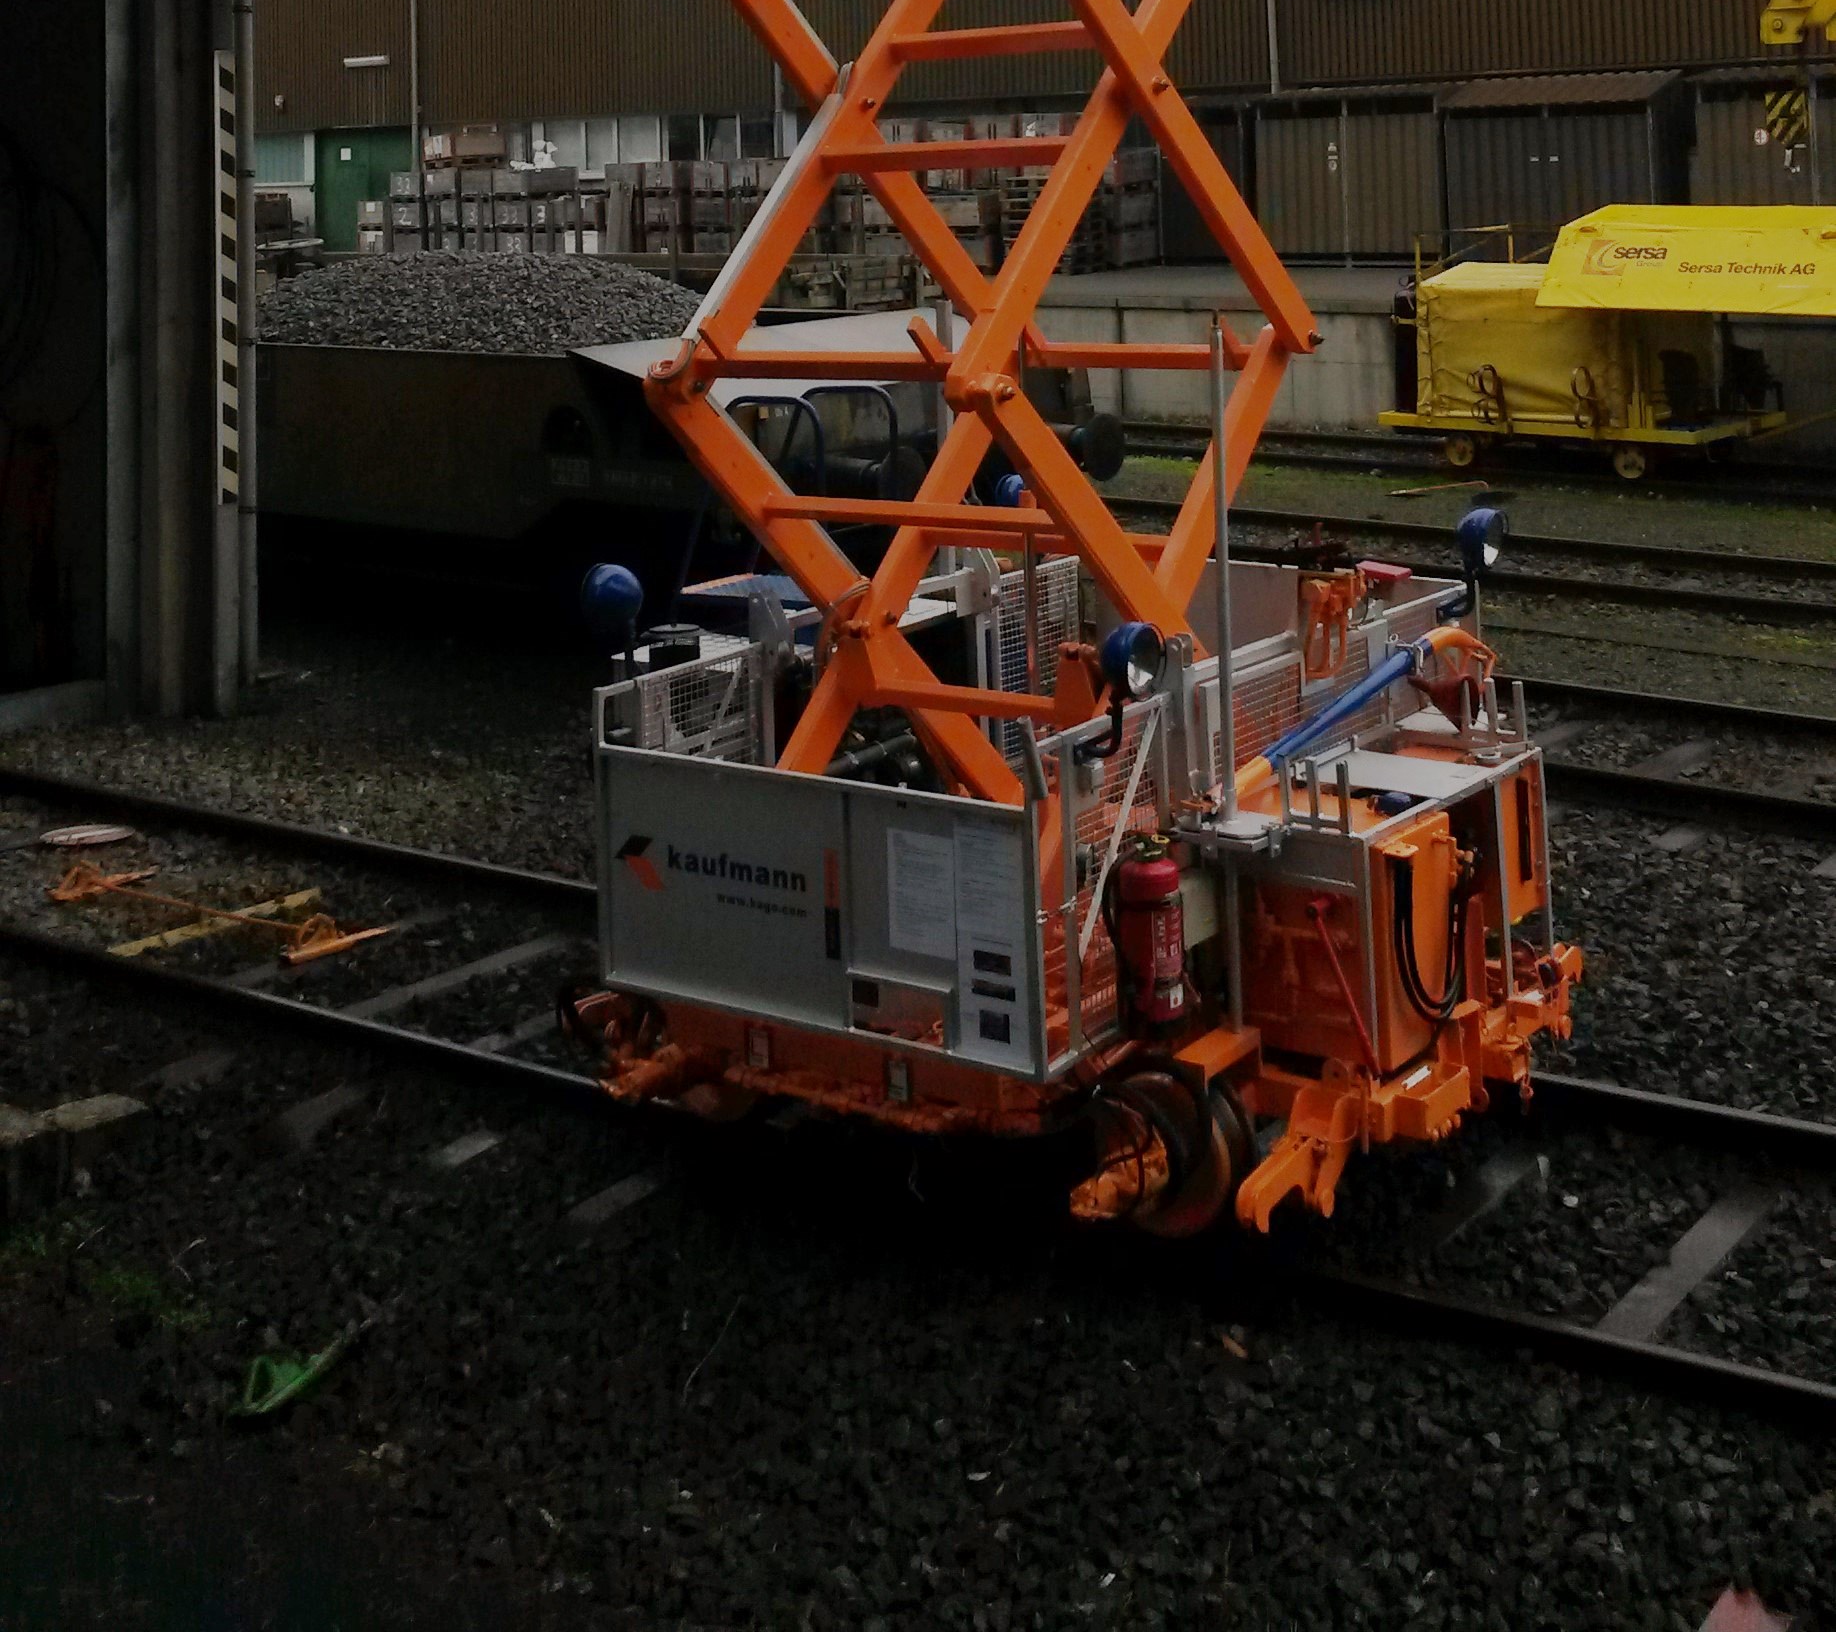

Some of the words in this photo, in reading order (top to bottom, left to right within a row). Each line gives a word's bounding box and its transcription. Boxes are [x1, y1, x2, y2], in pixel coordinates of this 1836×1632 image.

[398, 207, 412, 225] 2
[1613, 246, 1668, 260] sersa
[1677, 261, 1723, 274] Sersa
[1727, 262, 1788, 275] Technik
[1790, 263, 1816, 275] AG
[667, 844, 806, 892] kaufmann
